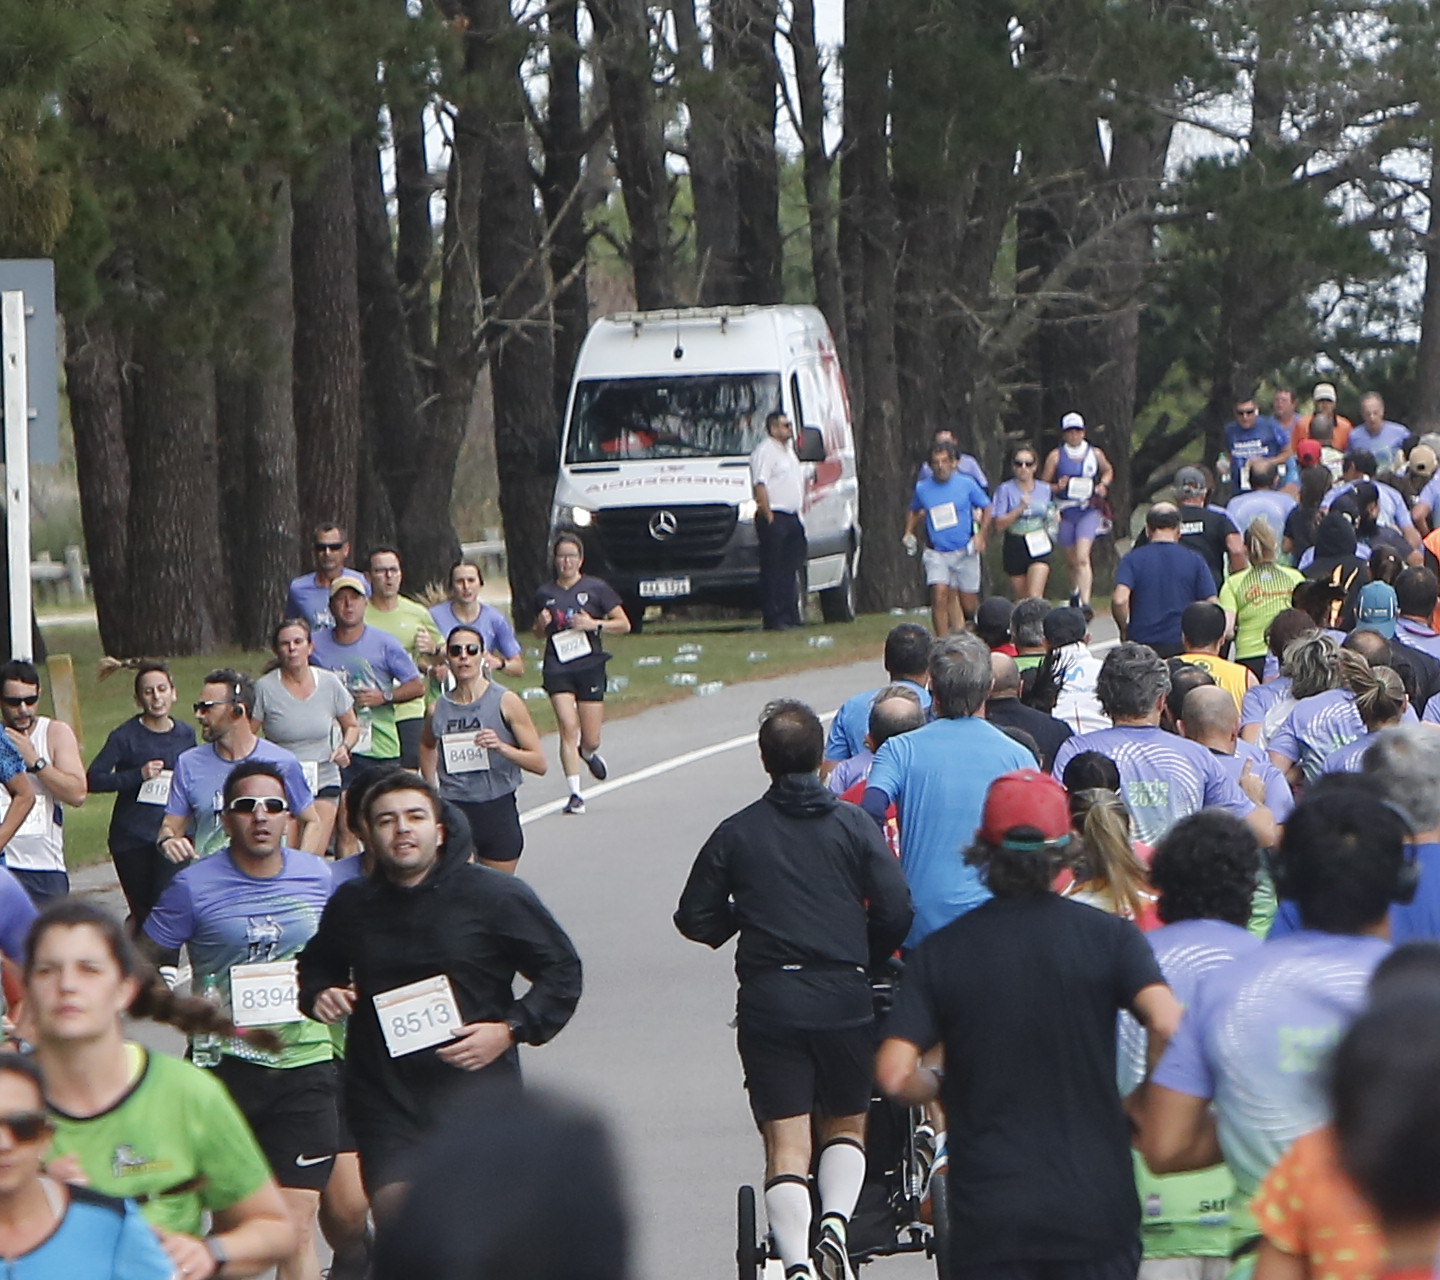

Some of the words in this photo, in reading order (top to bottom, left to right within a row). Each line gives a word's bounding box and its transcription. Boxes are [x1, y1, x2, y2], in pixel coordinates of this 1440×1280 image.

[447, 717, 481, 732] FILA
[450, 747, 483, 762] 8494
[145, 783, 168, 797] 819
[241, 986, 298, 1010] 8394
[391, 1002, 452, 1038] 8513
